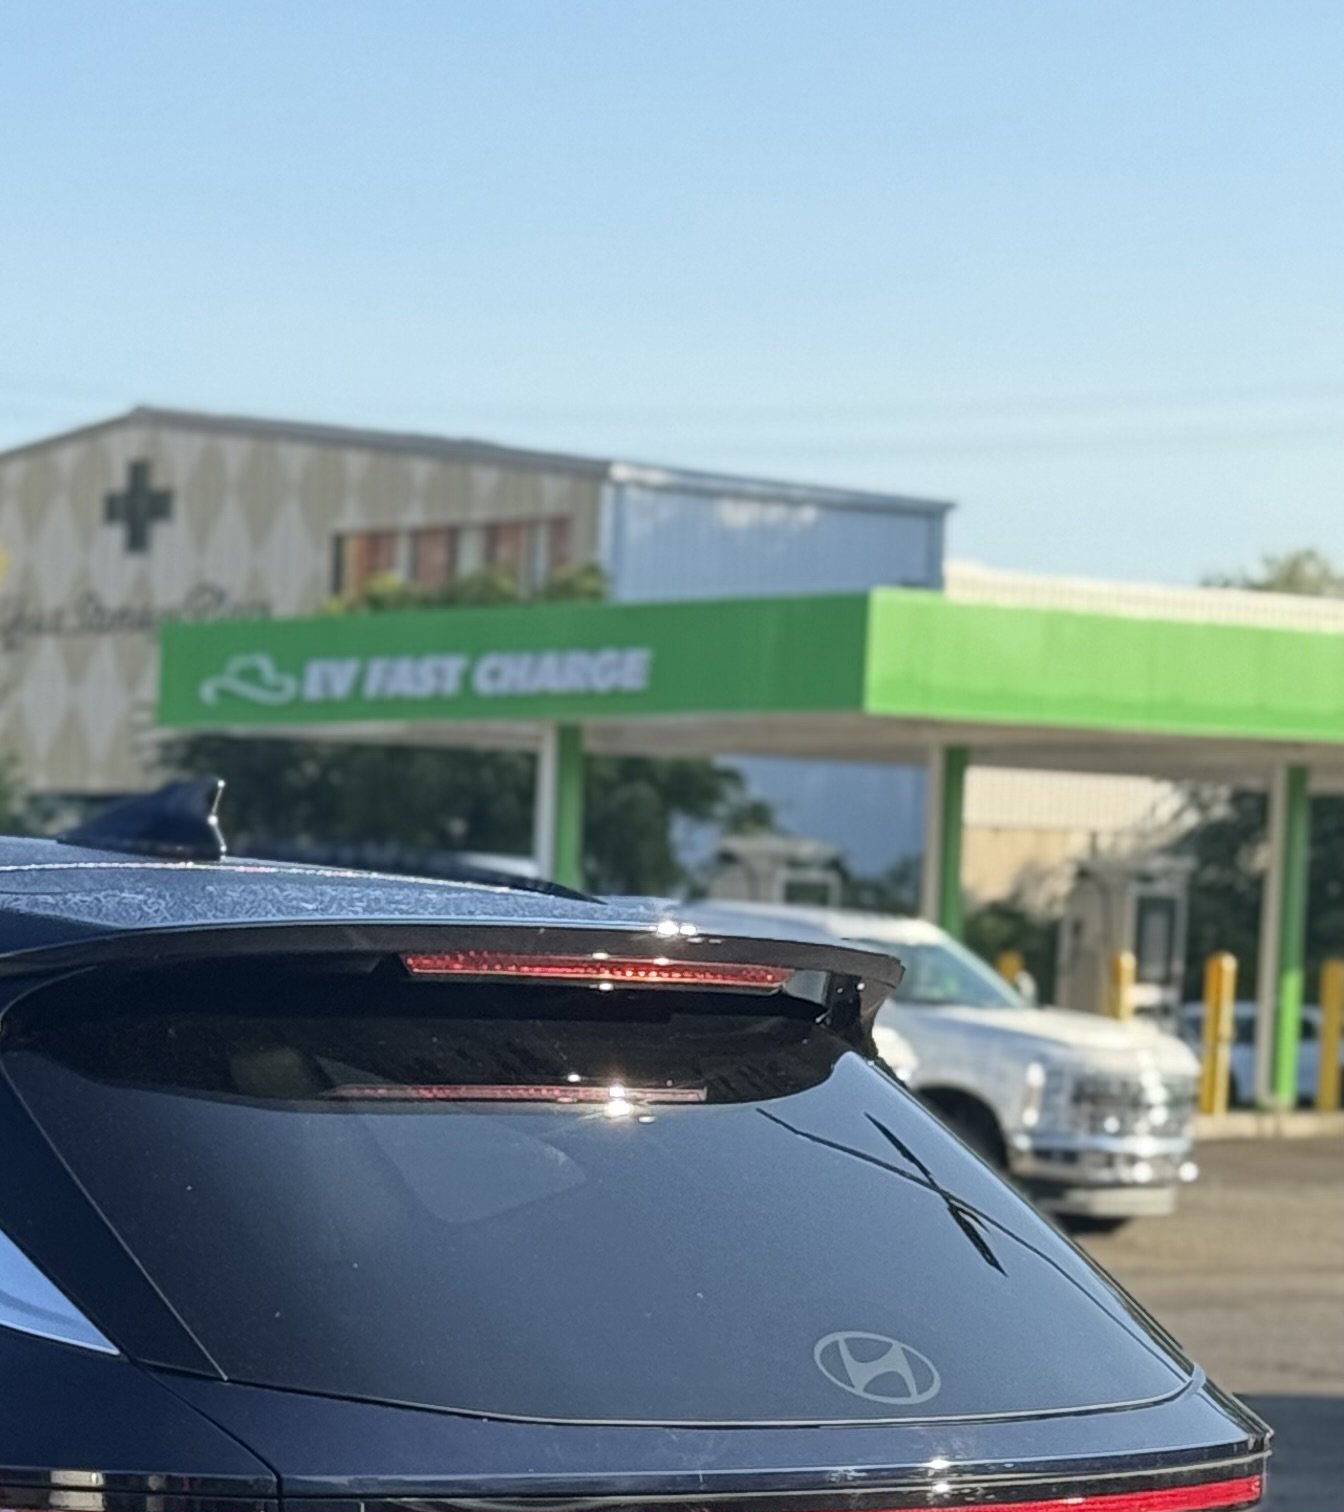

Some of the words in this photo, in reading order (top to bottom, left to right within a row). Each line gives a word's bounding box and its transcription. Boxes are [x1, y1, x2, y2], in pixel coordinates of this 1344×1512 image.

[304, 658, 359, 700] EV
[365, 653, 468, 698] FAST
[473, 647, 651, 693] CHARGE
